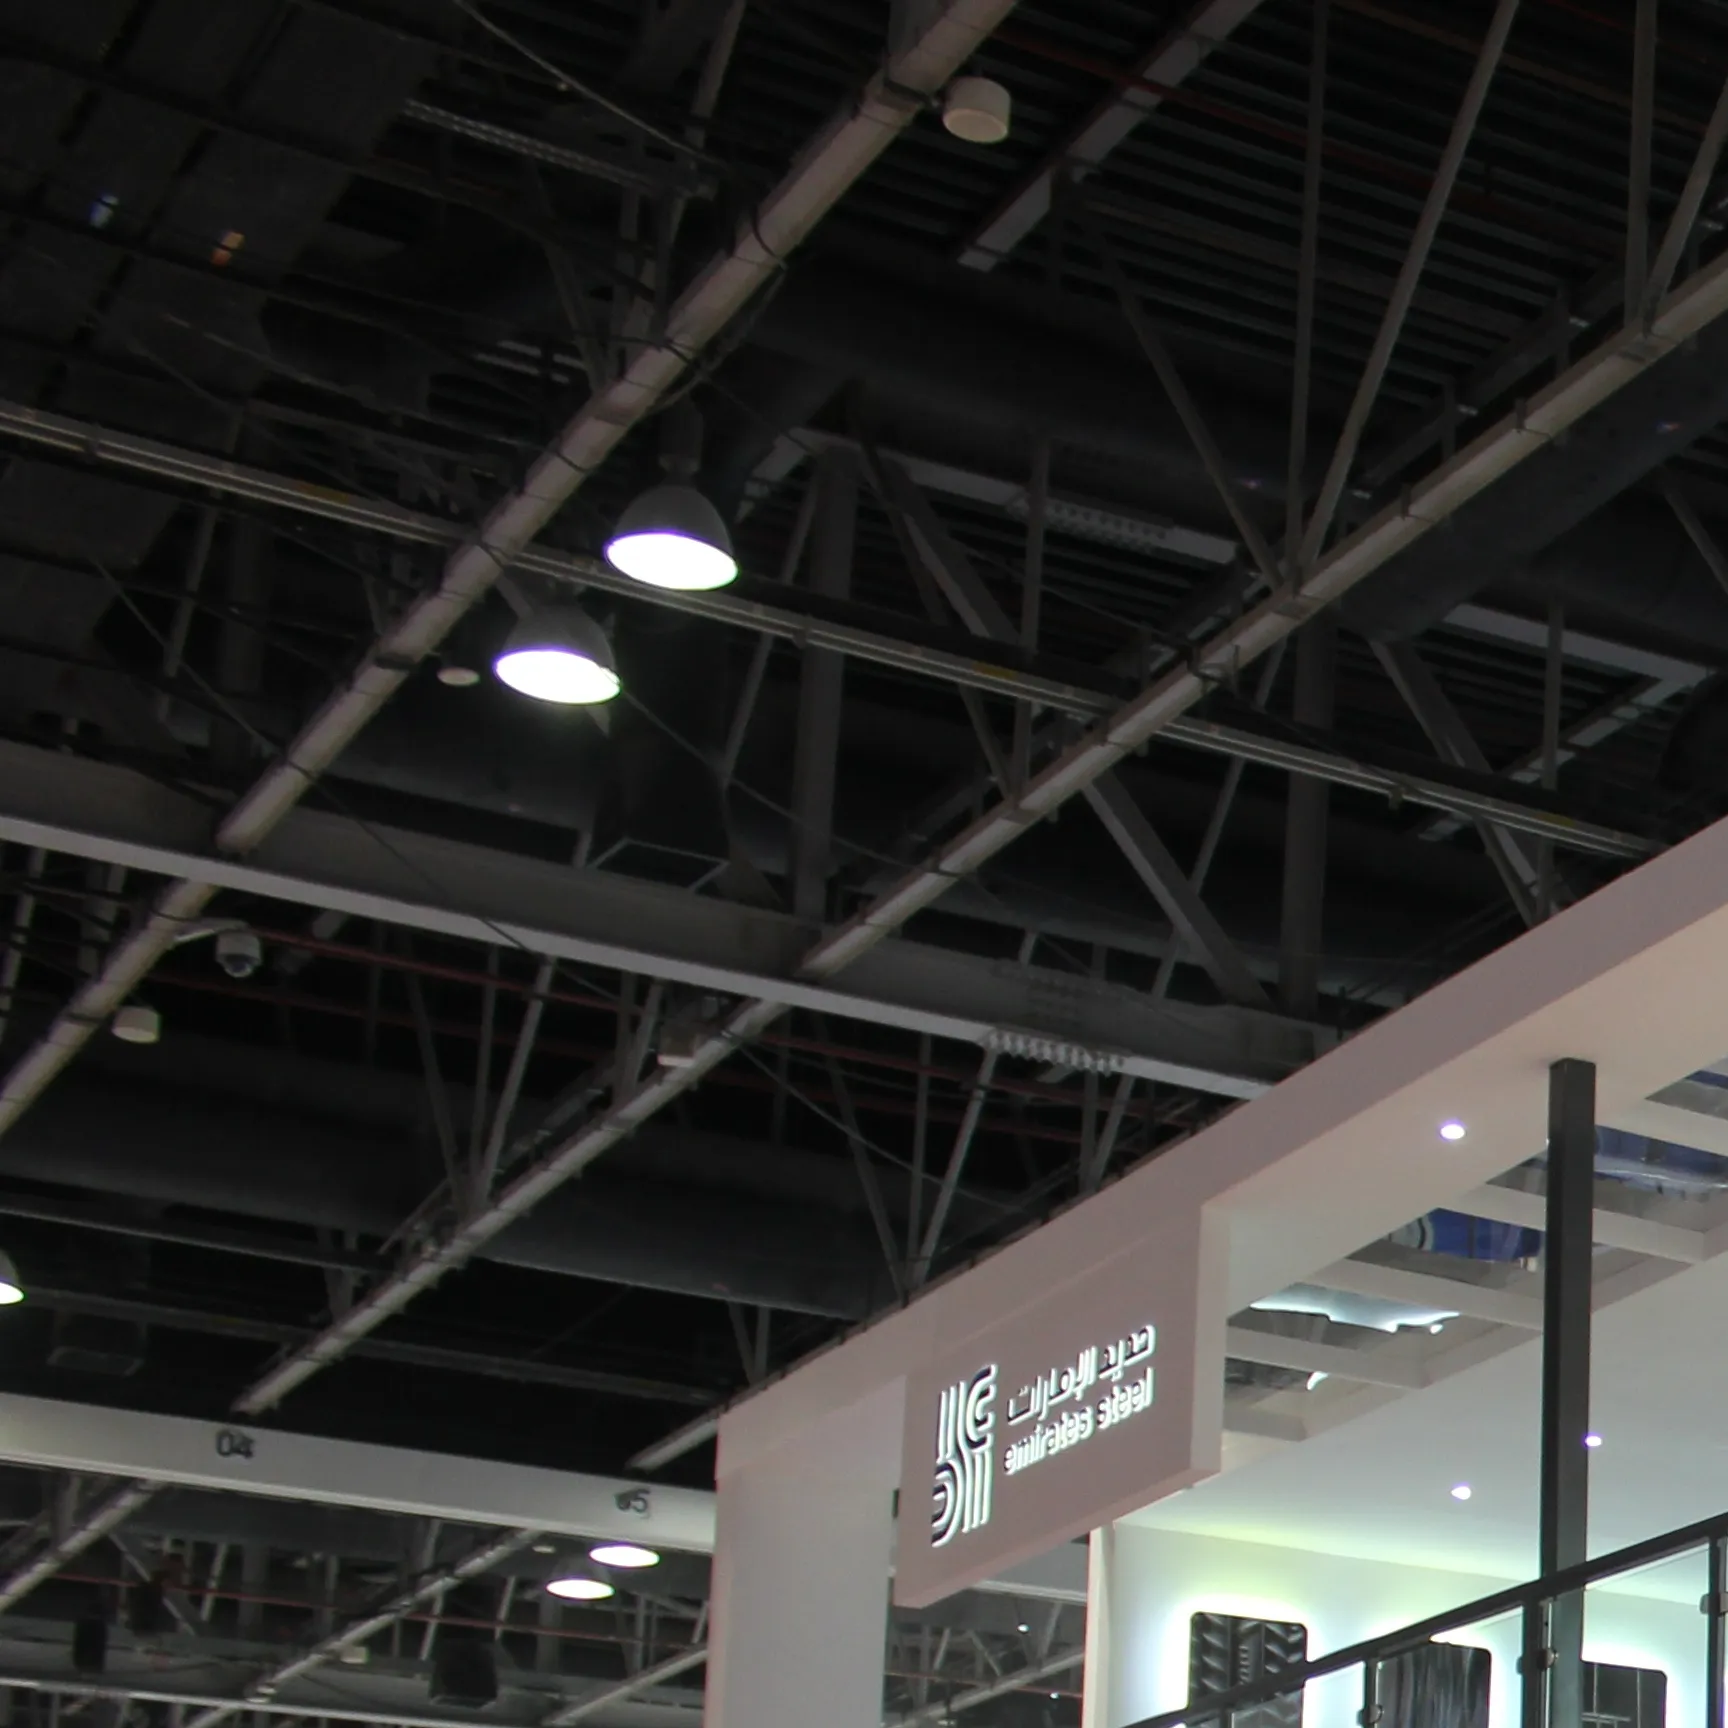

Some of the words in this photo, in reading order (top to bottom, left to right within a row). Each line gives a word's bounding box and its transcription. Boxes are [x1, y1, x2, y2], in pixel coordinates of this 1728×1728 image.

[1099, 1325, 1157, 1381] حديد
[1004, 1406, 1093, 1475] emirates
[1097, 1366, 1154, 1429] steel
